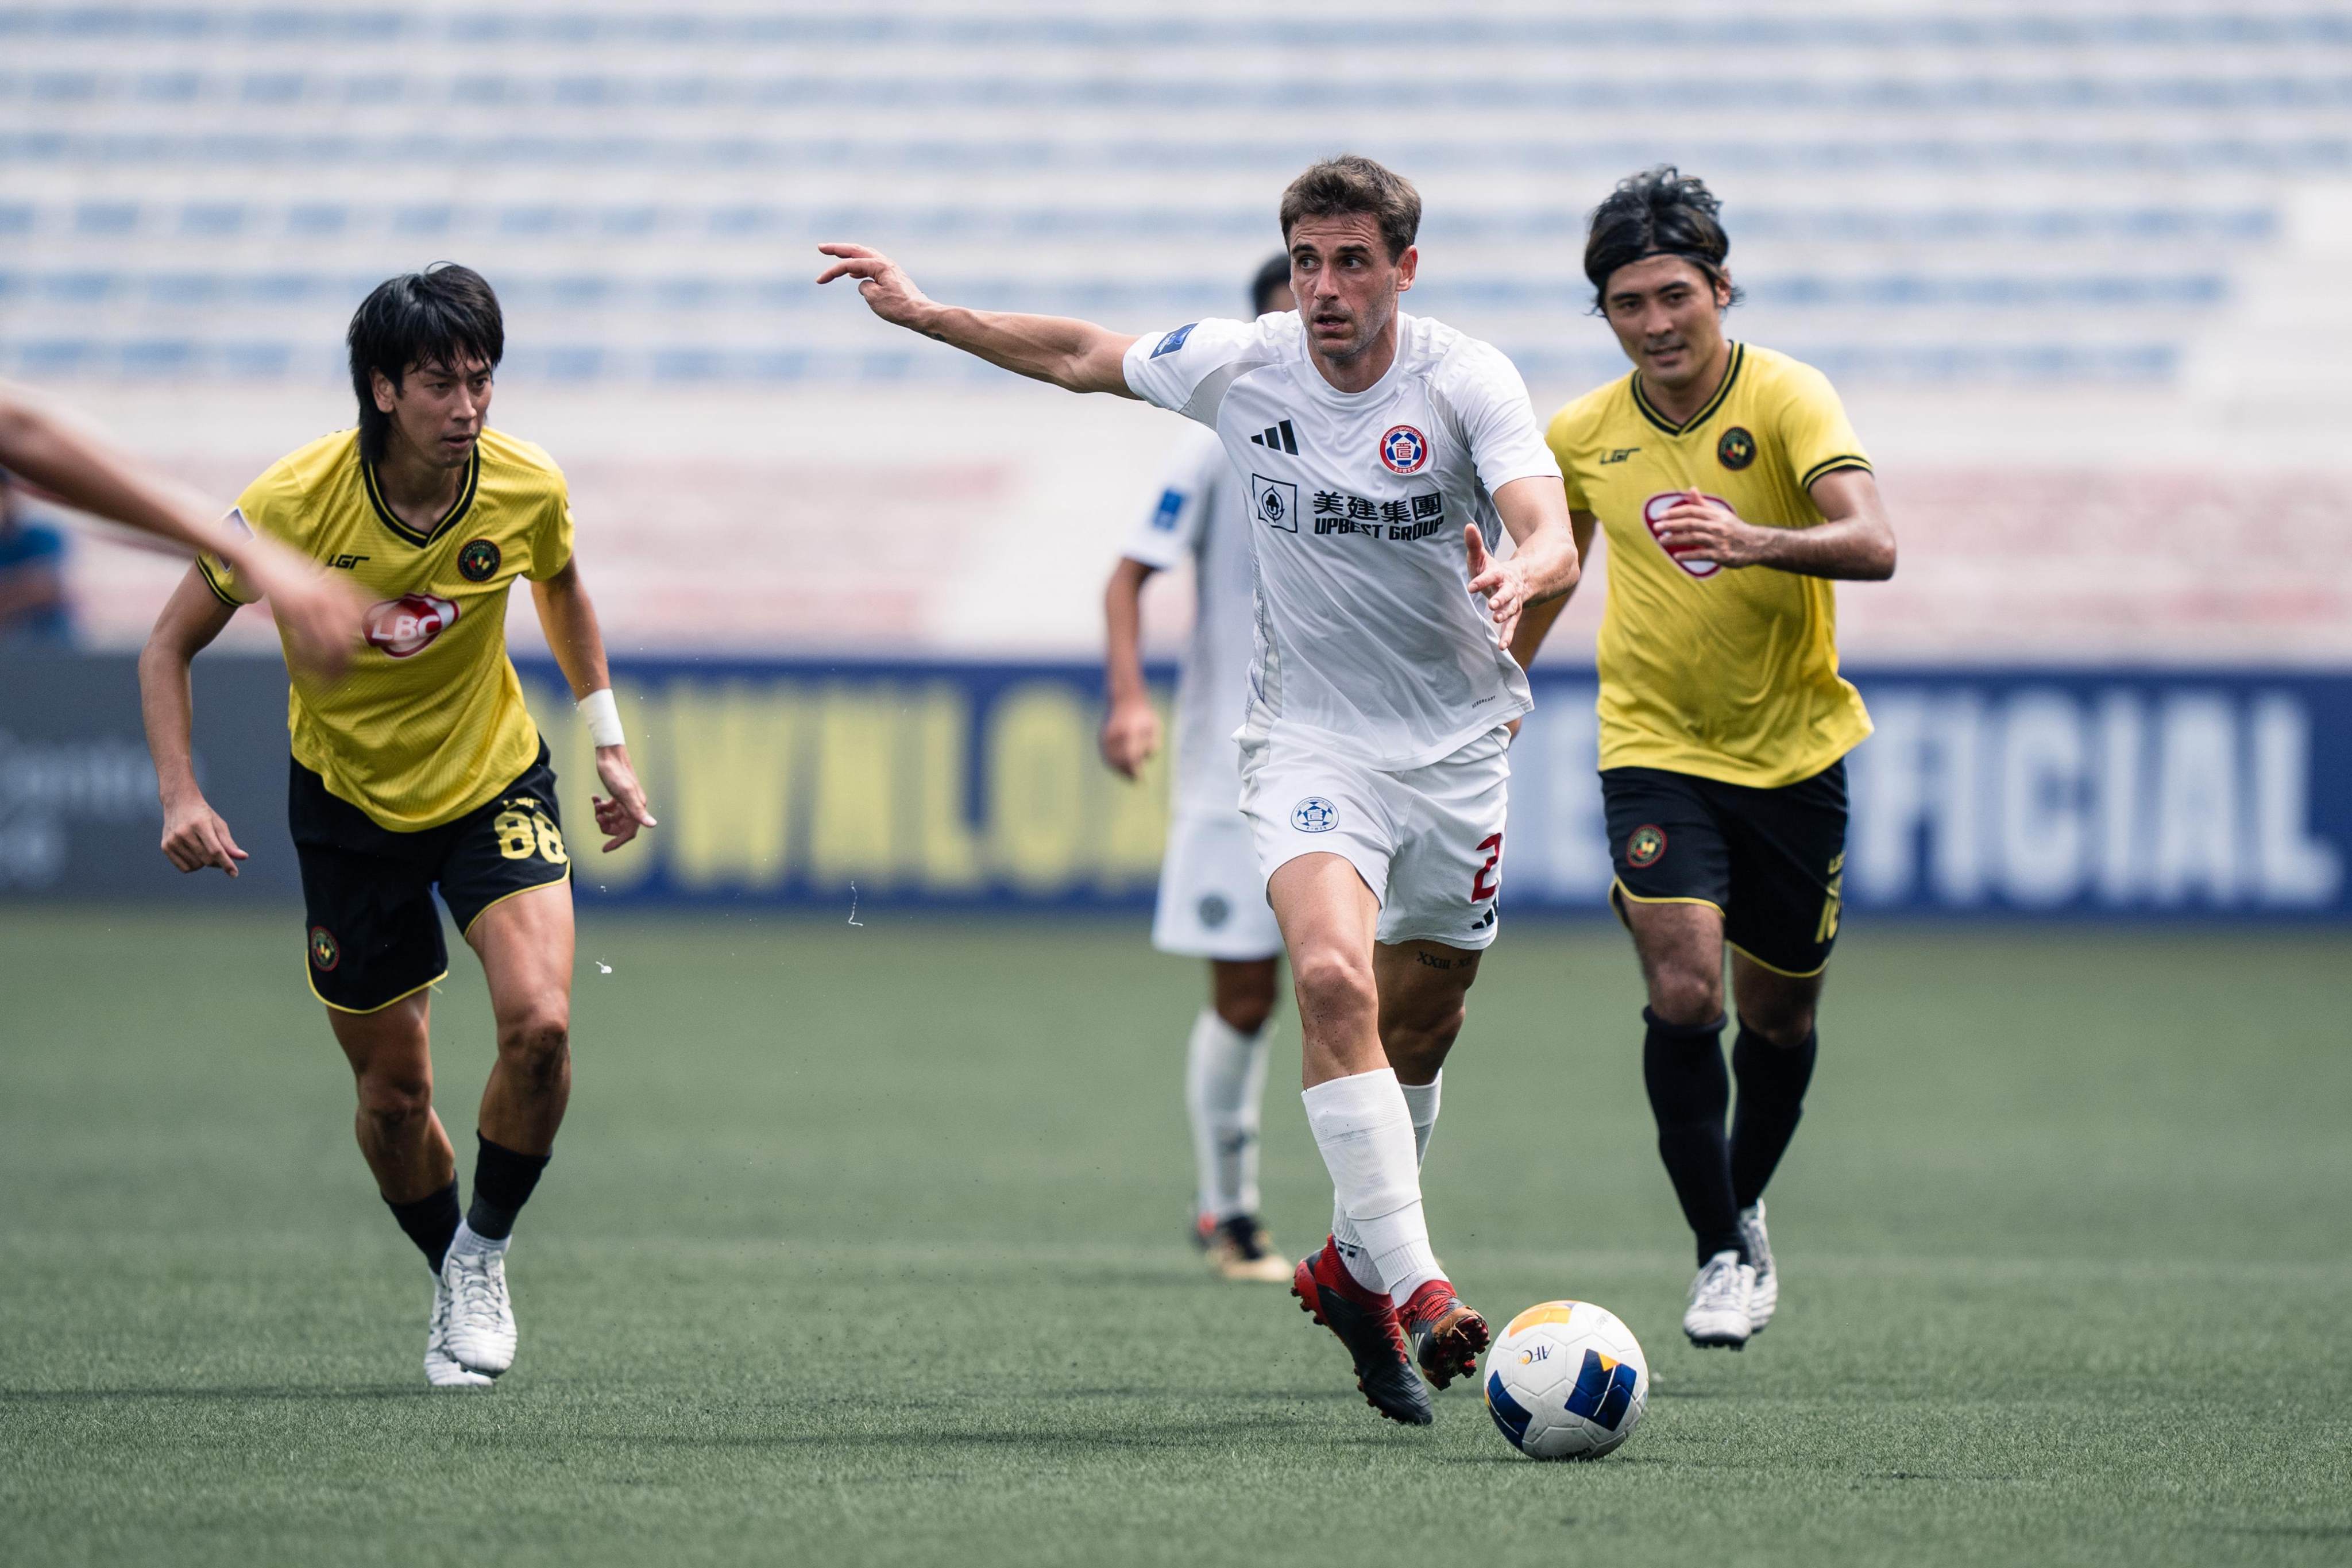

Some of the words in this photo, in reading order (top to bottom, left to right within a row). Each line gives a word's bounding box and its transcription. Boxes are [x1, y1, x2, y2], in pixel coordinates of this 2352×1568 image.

[1313, 490, 1443, 524] 美建集團
[1314, 517, 1383, 539] UPBEST
[1389, 515, 1444, 541] GROUP
[372, 614, 441, 642] LBC
[1852, 689, 2340, 903] FICIAL
[1518, 1343, 1555, 1366] AFC
